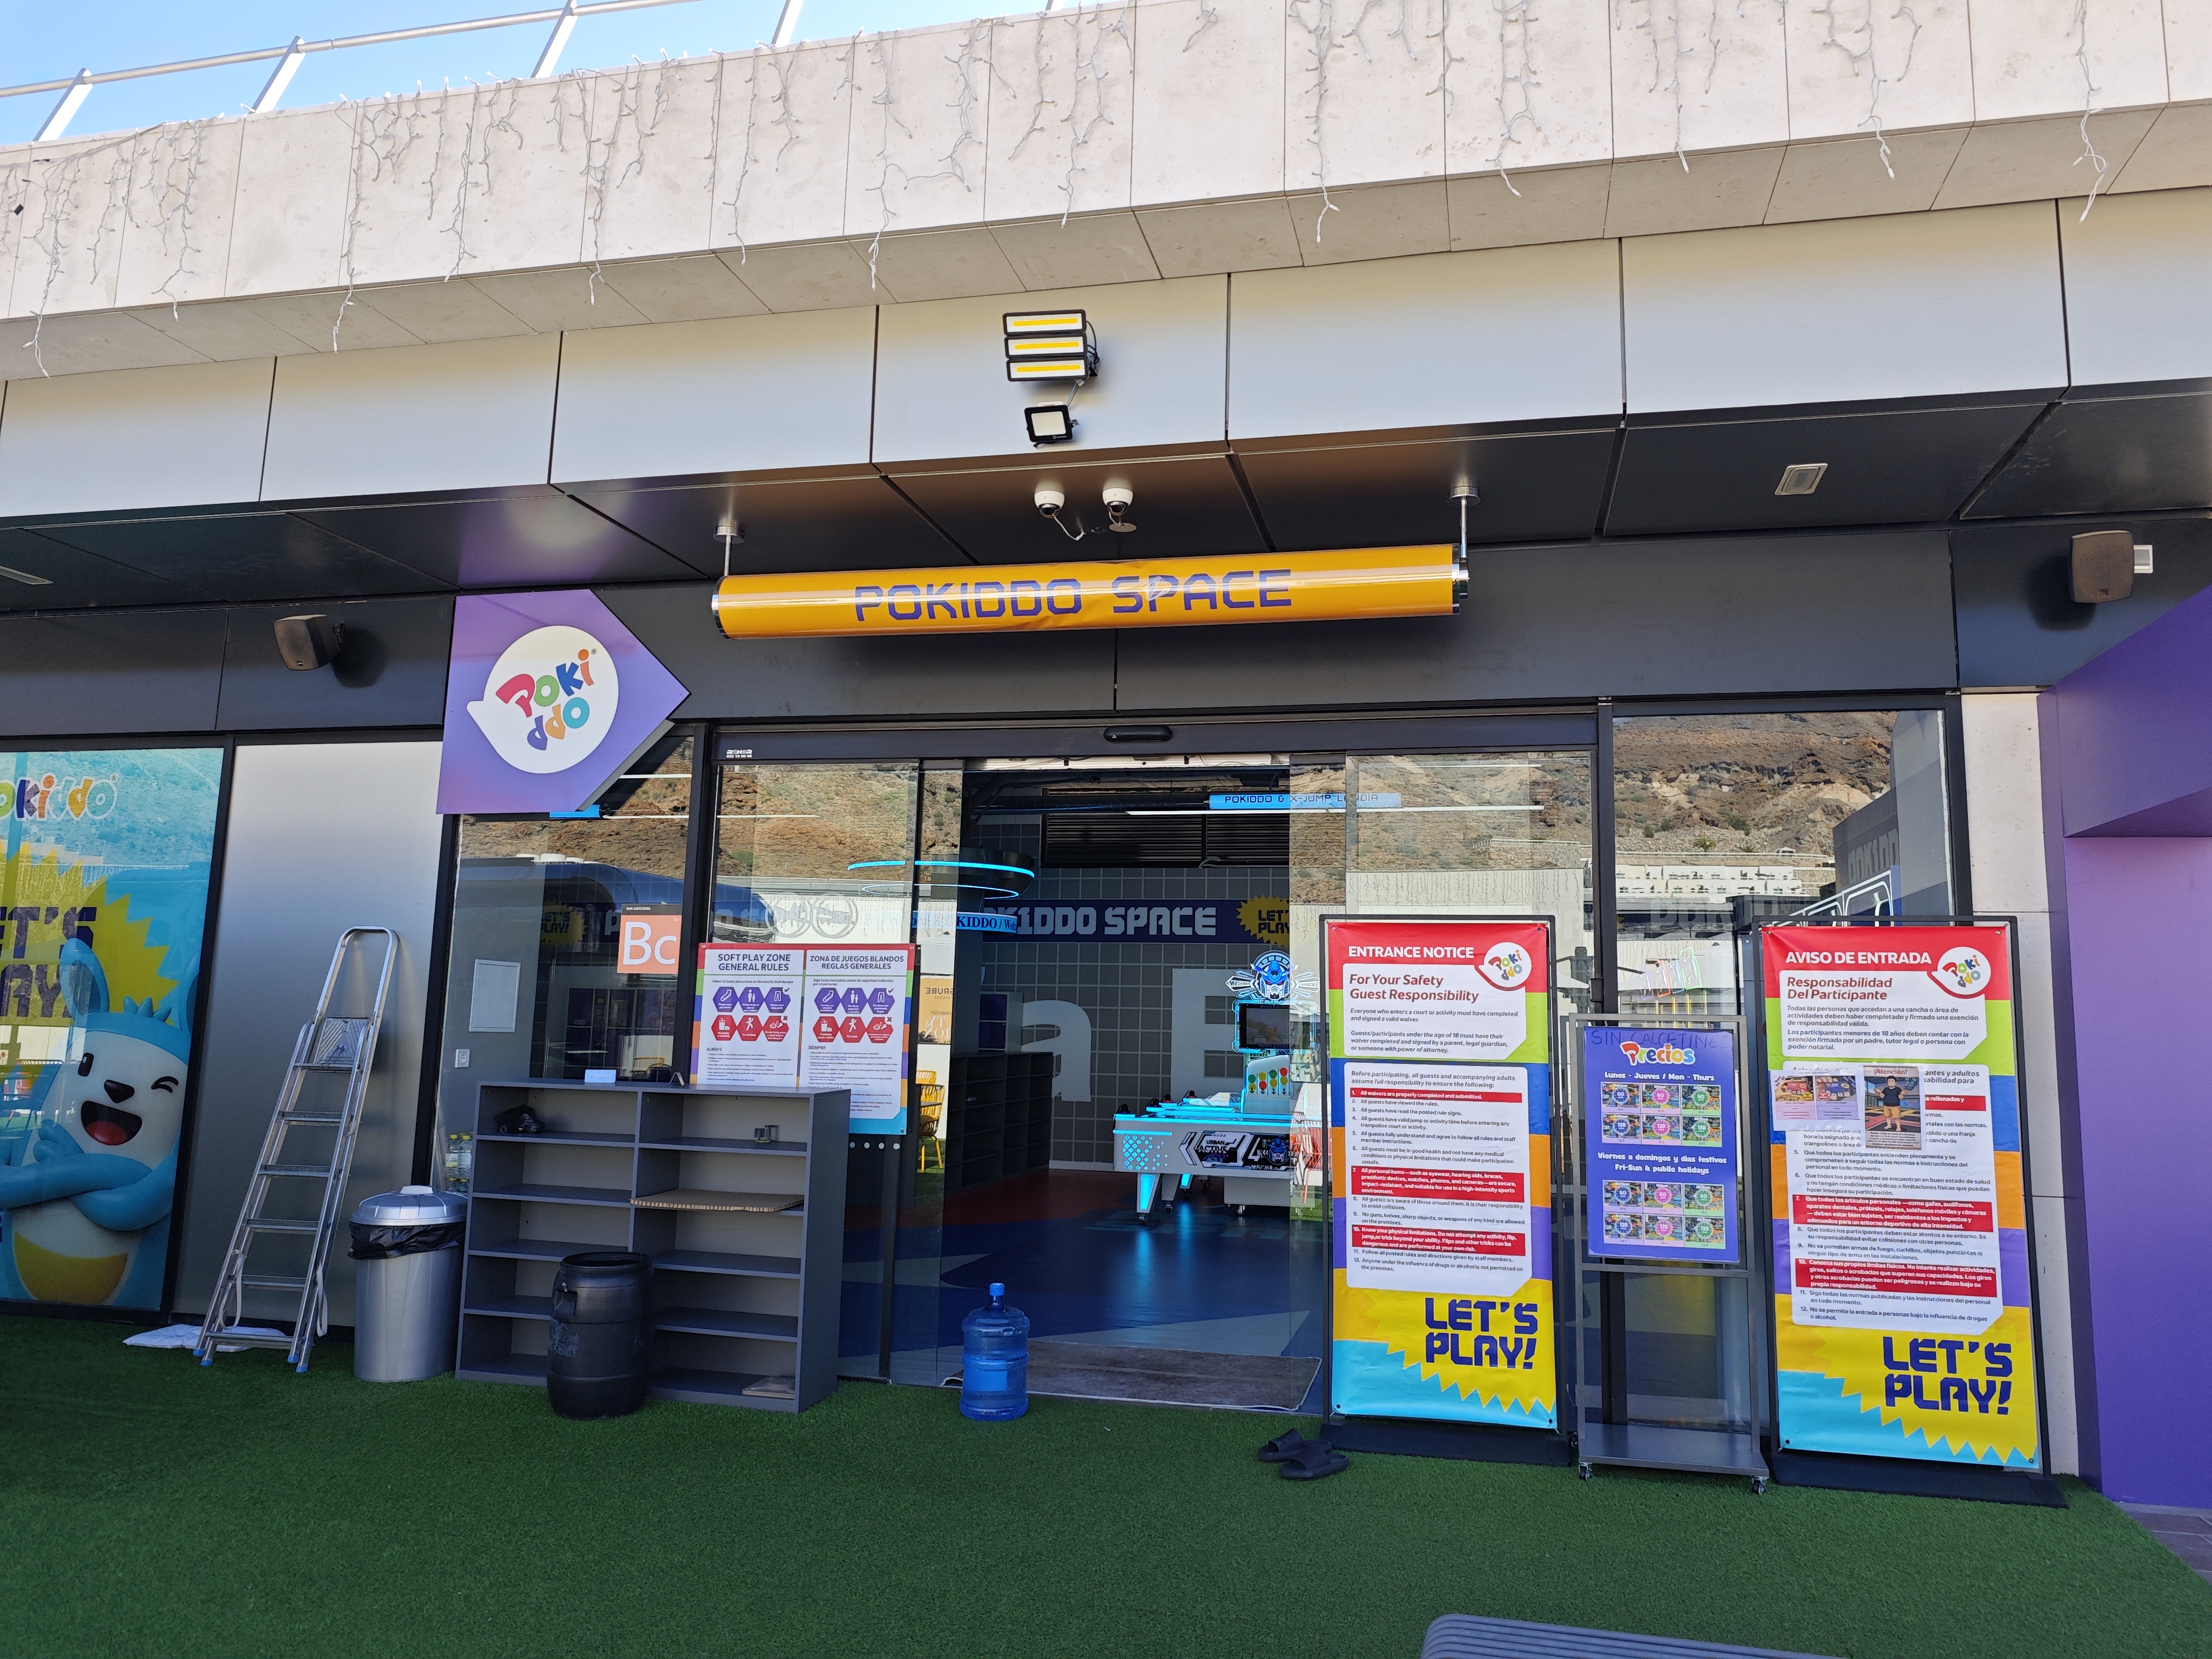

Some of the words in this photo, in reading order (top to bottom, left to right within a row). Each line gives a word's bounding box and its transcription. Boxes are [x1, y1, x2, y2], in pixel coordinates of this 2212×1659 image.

[855, 578, 1081, 621] POKIDDO
[1111, 569, 1292, 613] SPACE
[542, 911, 570, 922] ET'S
[1104, 907, 1216, 936] SPACE
[1258, 910, 1289, 922] LET'
[1258, 922, 1289, 934] PLAY
[623, 921, 677, 965] Bc
[1348, 946, 1421, 957] ENTRANCE
[1423, 947, 1474, 959] NOTICE
[1785, 952, 1833, 964] AVISO
[1835, 952, 1856, 964] DE
[1858, 952, 1932, 965] ENTRADA
[761, 963, 789, 971] RULES
[1349, 974, 1371, 984] For
[1372, 974, 1401, 984] Your
[1402, 974, 1444, 988] Safety
[1787, 976, 1892, 989] Responsabilidad
[1350, 988, 1387, 999] Guest
[1388, 989, 1479, 1003] Responsibility
[1787, 989, 1809, 999] Del
[1811, 989, 1887, 1002] Participante
[1591, 1030, 1621, 1046] SIN
[1621, 1042, 1695, 1064] Precios
[1874, 1068, 1908, 1076] ¡Atención!
[1198, 1145, 1228, 1154] ACTIVE
[1597, 1152, 1626, 1160] Viernes
[1635, 1154, 1671, 1163] domingos
[1698, 1156, 1727, 1164] festivos
[1677, 1166, 1709, 1175] holidays
[1425, 1298, 1538, 1335] LET'S
[1425, 1332, 1537, 1370] PLAY!
[1883, 1337, 2013, 1378] LET'S
[1885, 1374, 2013, 1415] PLAY!
